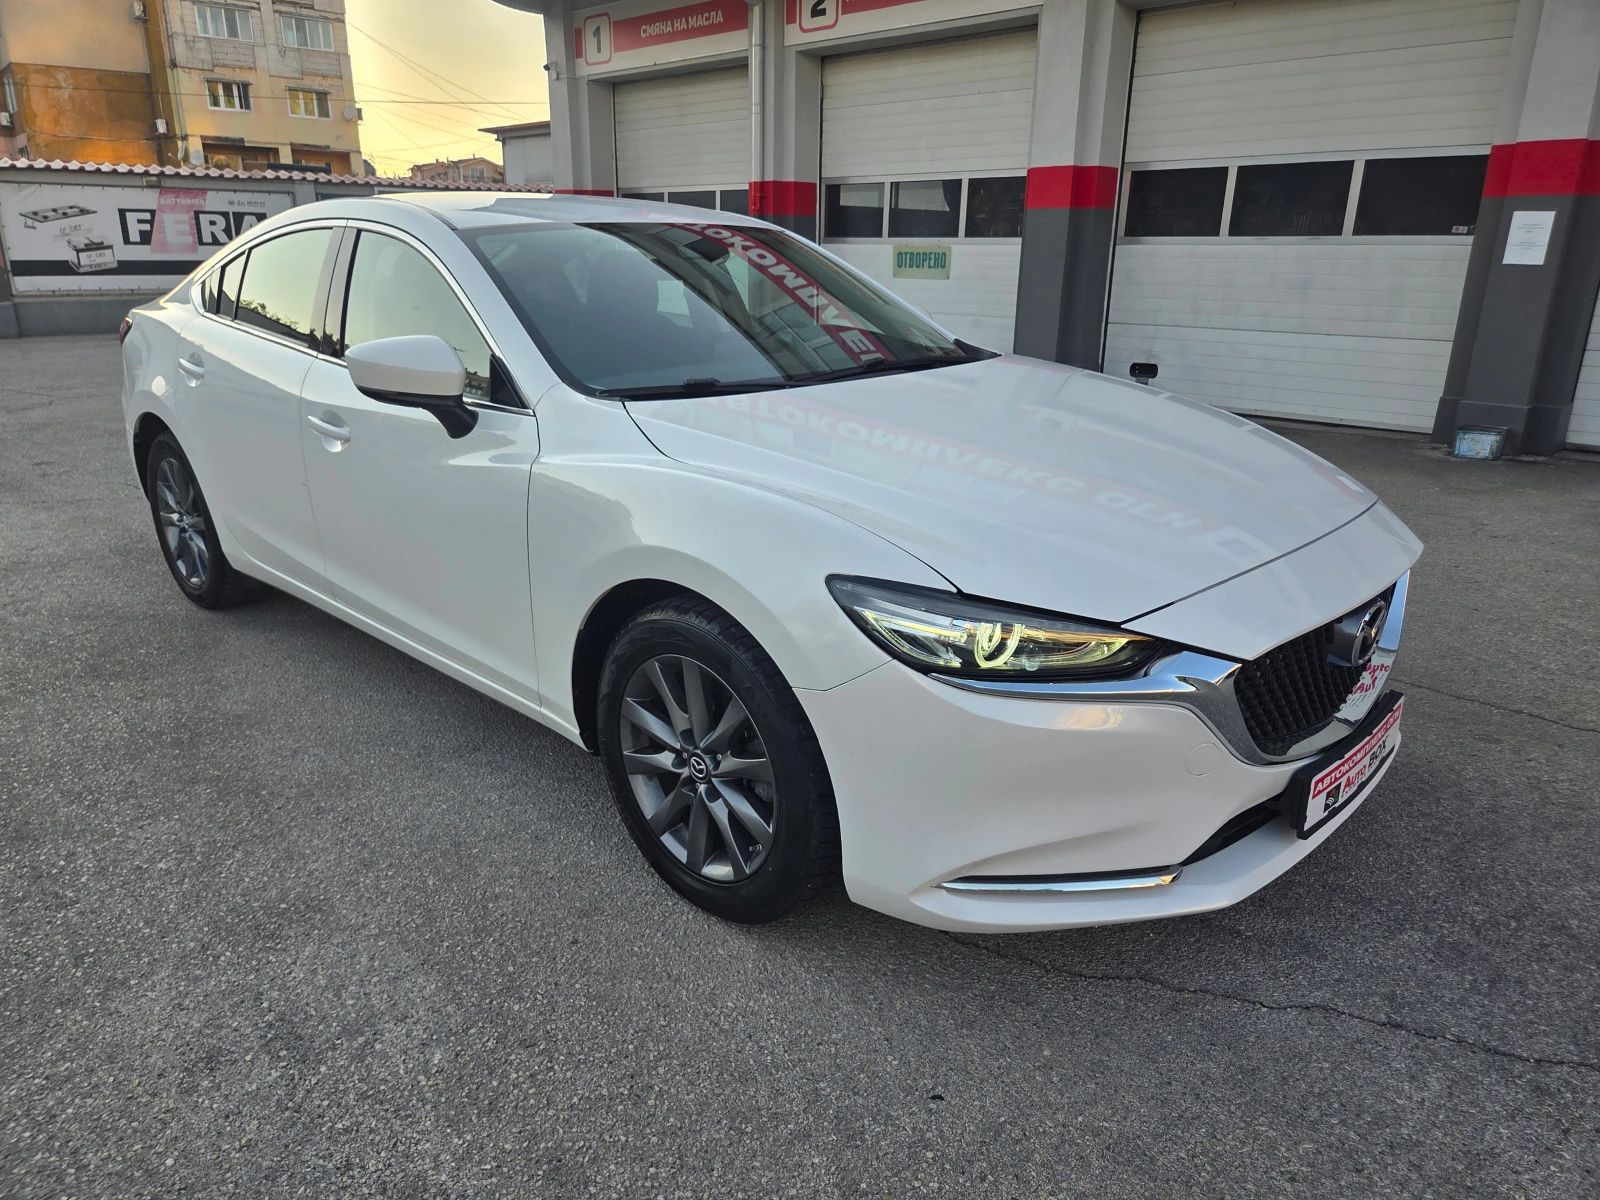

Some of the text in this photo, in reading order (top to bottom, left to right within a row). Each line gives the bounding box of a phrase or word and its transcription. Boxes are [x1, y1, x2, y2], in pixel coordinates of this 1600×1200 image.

[640, 10, 724, 38] СМЯНА НА МАСЛА
[592, 25, 602, 54] 1
[897, 252, 947, 269] ОТВОРЕНО
